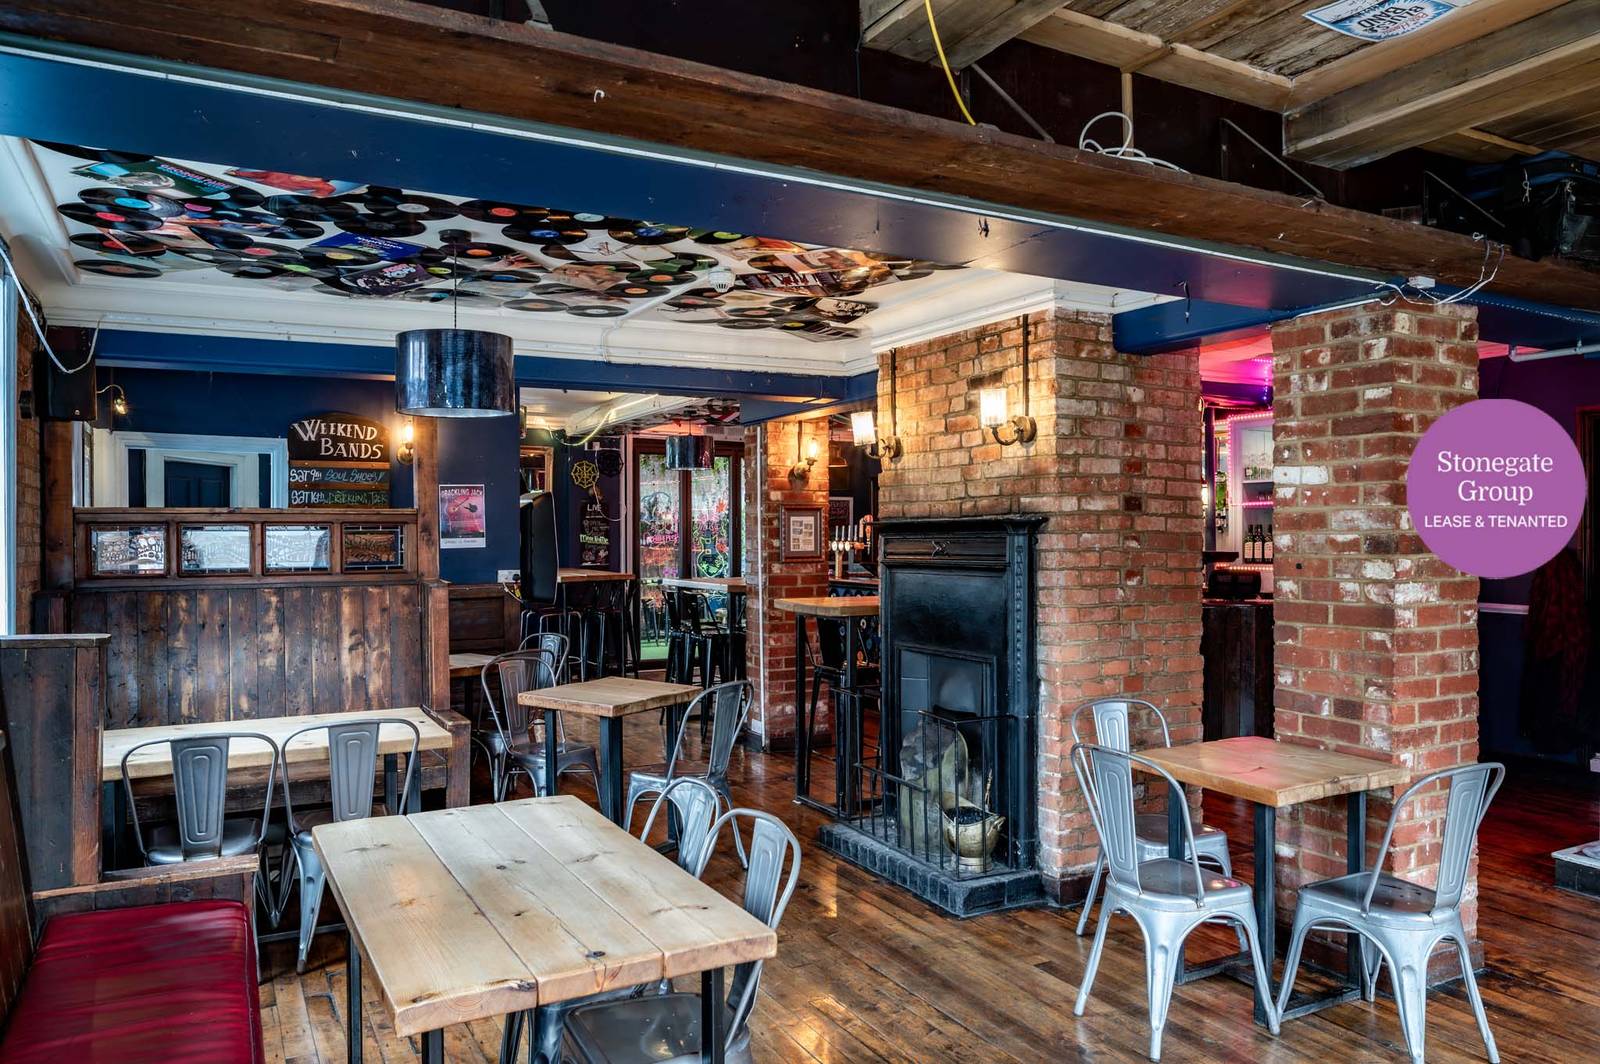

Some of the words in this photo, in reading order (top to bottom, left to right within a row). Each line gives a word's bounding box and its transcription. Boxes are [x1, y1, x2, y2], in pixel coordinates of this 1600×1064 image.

[1358, 7, 1407, 28] BAND
[292, 419, 378, 441] WEEKEND
[319, 437, 384, 459] BANDS
